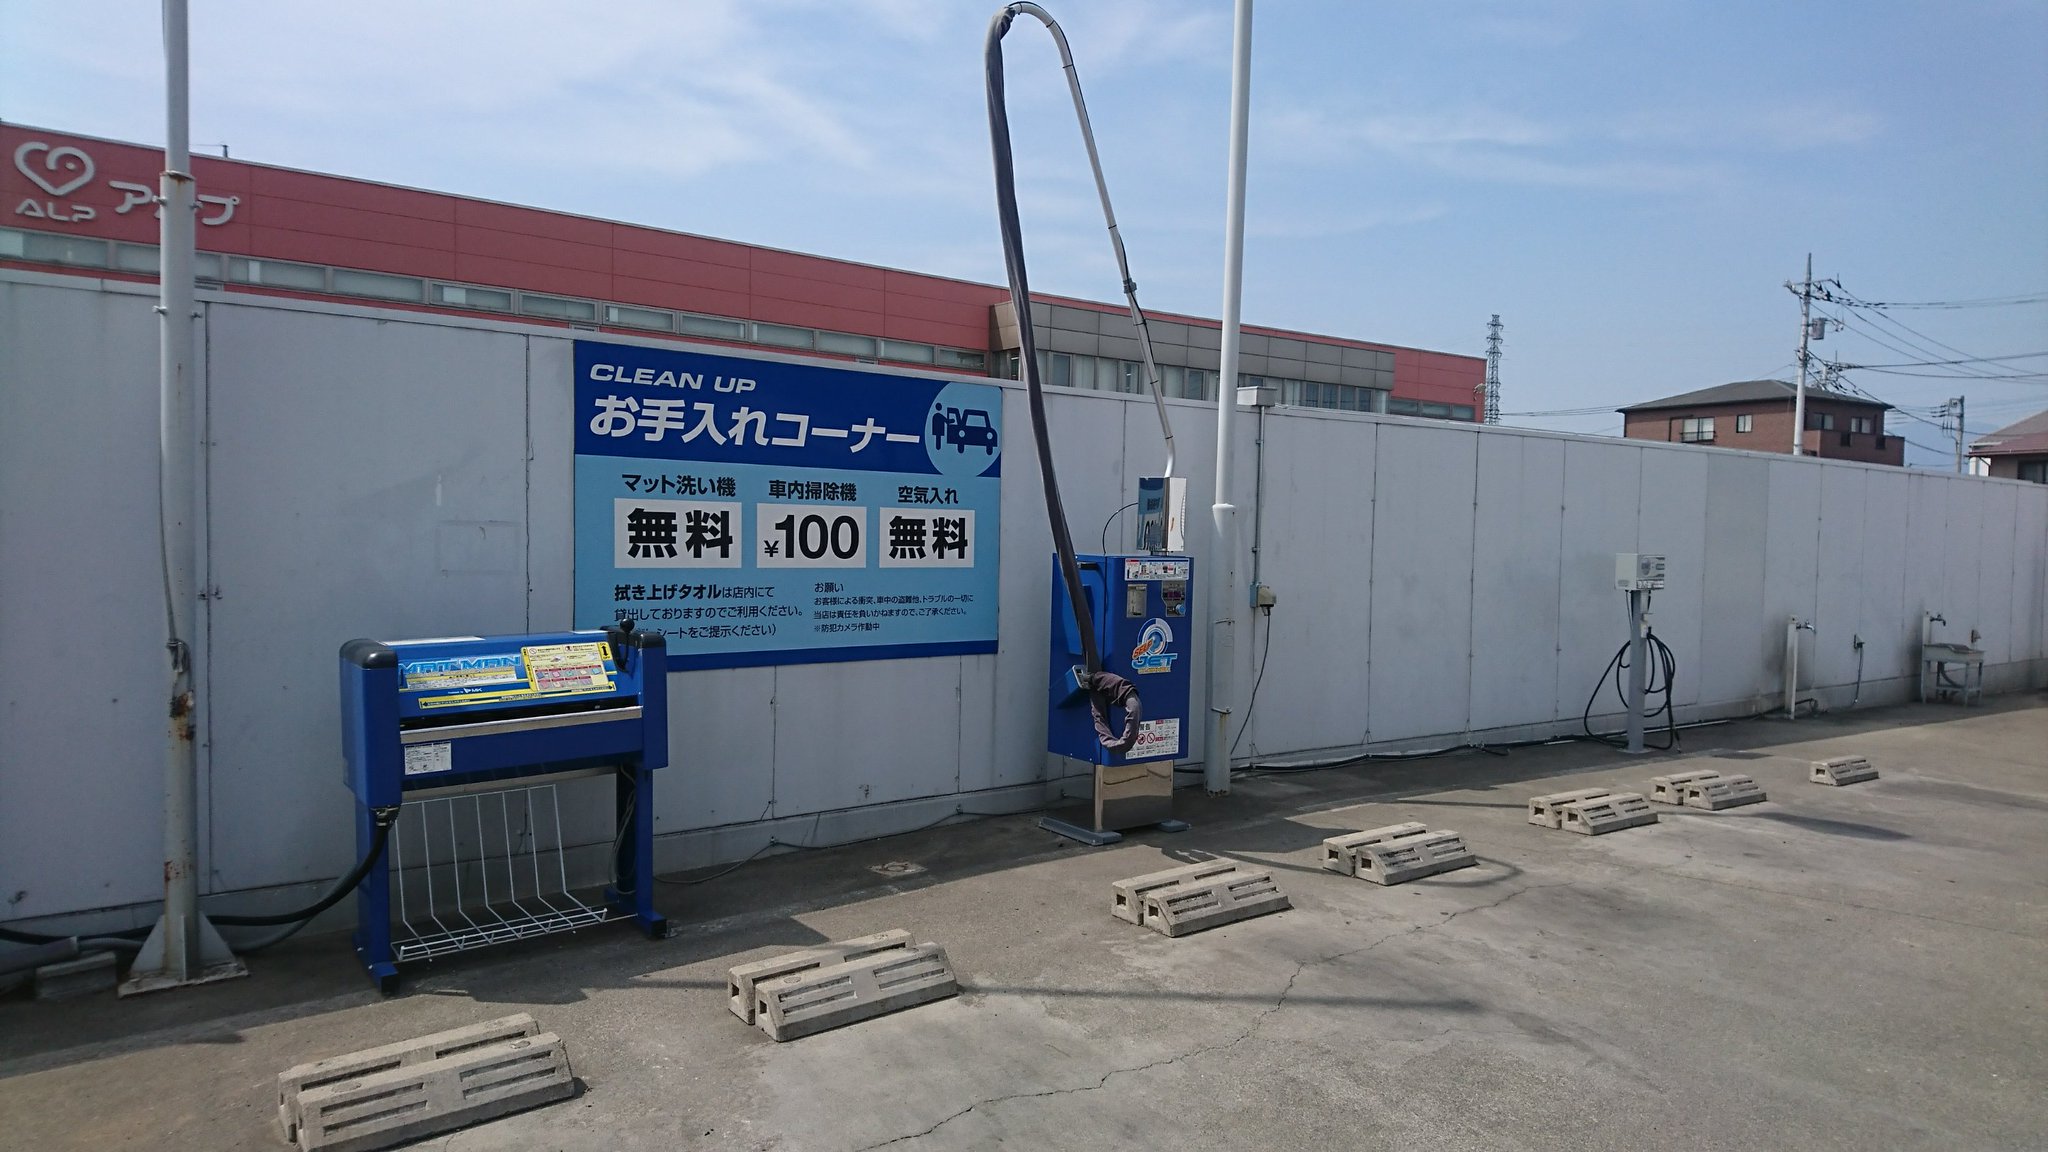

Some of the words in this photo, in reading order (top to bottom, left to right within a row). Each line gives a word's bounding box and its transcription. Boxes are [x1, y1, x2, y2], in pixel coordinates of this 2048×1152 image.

[15, 198, 97, 223] ALP
[109, 180, 241, 226] アプ
[589, 363, 704, 391] CLEAN
[714, 376, 757, 394] UP
[588, 394, 921, 454] お手入れコーナー
[621, 473, 737, 498] マット洗い機
[768, 479, 858, 503] 車内掃除機
[897, 485, 960, 505] 空気入れ
[626, 507, 734, 560] 無料
[763, 513, 861, 560] ¥100
[888, 515, 969, 560] 無料
[614, 583, 776, 602] 拭き上げタオルは店内にて
[813, 581, 845, 594] お願い
[1132, 653, 1178, 669] JET
